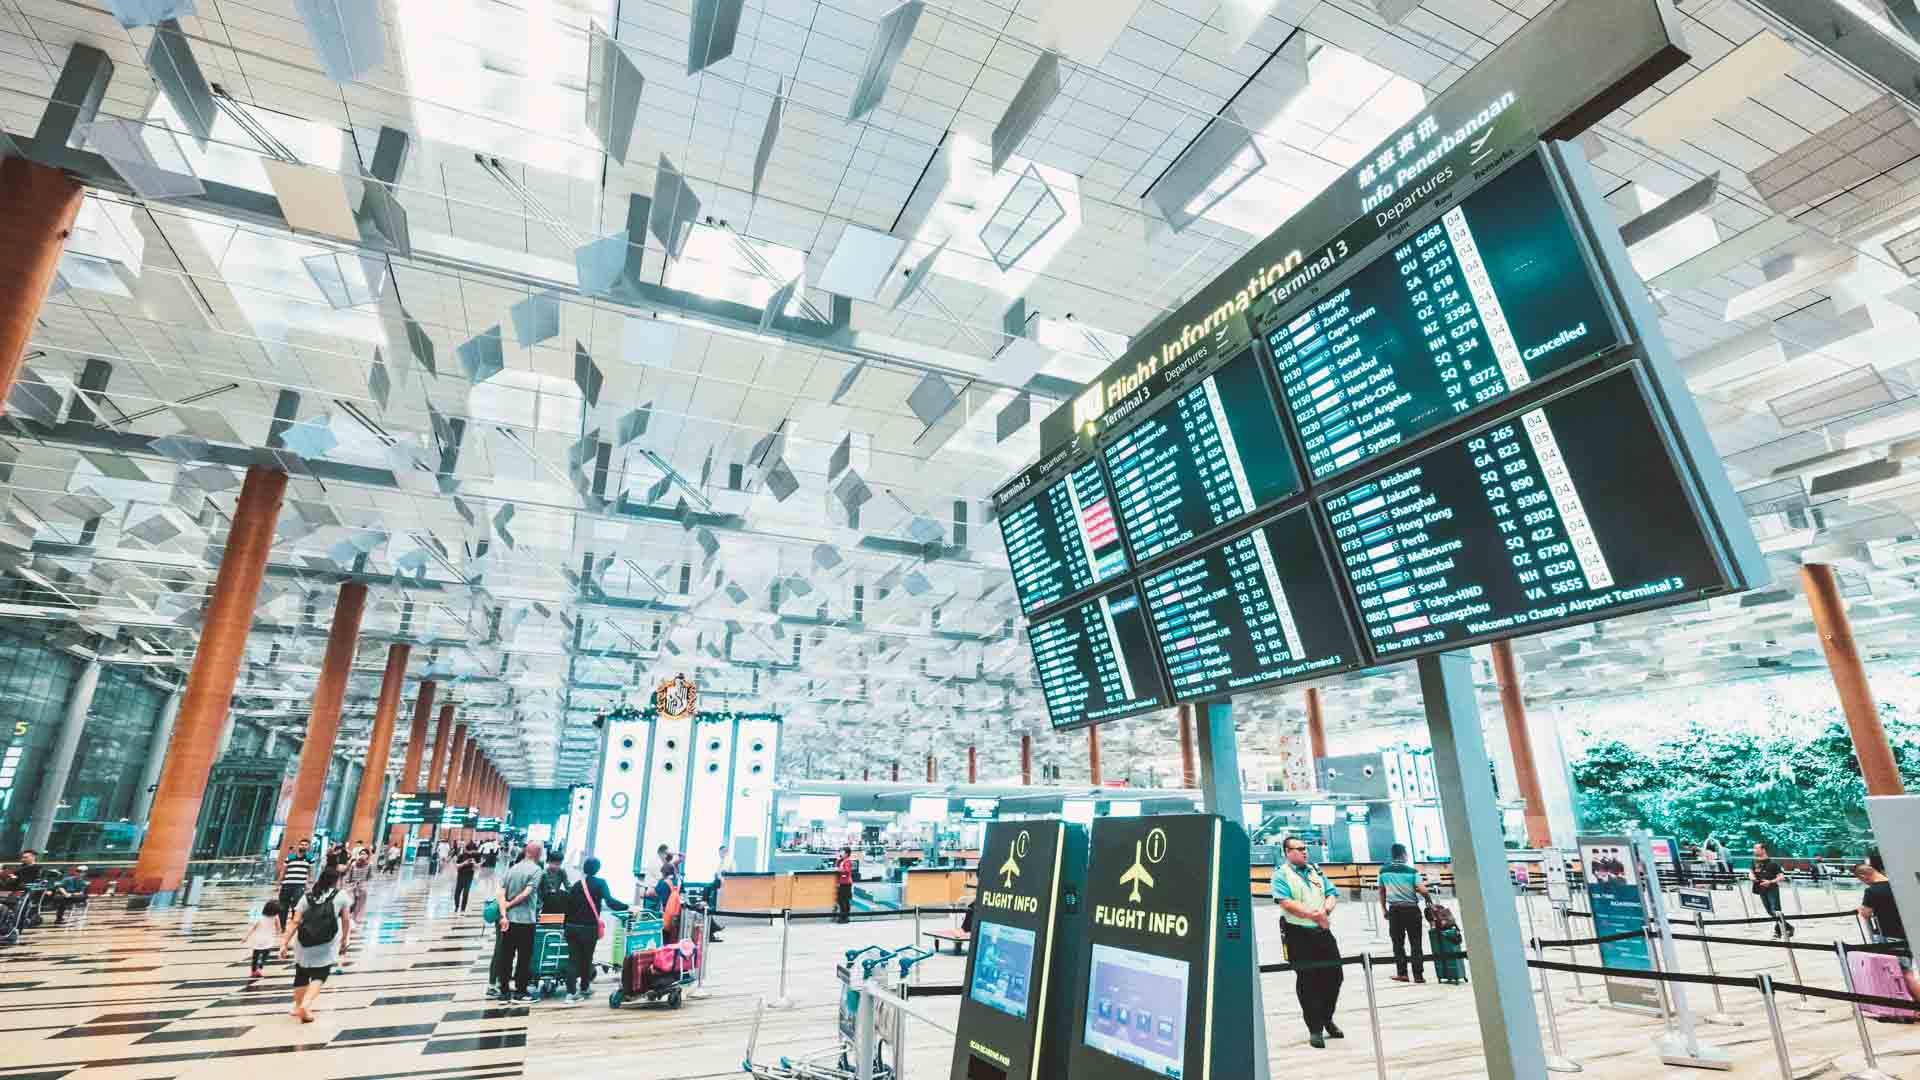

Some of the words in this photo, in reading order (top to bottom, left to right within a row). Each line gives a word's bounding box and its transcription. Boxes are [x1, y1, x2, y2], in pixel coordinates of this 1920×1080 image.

[1361, 183, 1394, 214] Info
[1396, 91, 1514, 186] Penerbangan
[1268, 252, 1335, 305] Terminal
[1337, 240, 1349, 257] 3
[1375, 167, 1454, 228] Departures
[1270, 328, 1288, 345] 0120
[1318, 289, 1350, 314] Nagoya
[1395, 245, 1412, 261] NH
[1416, 225, 1442, 247] 6268
[1447, 213, 1460, 226] 04
[1275, 341, 1293, 357] 0130
[1322, 306, 1349, 327] Zurich
[1401, 259, 1418, 275] OU
[1421, 240, 1447, 262] 5815
[1453, 228, 1466, 242] 04
[1279, 354, 1297, 370] 0130
[1328, 324, 1349, 340] Cape
[1349, 307, 1376, 326] Town
[1406, 276, 1422, 291] SA
[1427, 256, 1453, 278] 7231
[1108, 358, 1157, 407] Flight
[1163, 249, 1304, 363] Information
[1284, 368, 1302, 384] 0130
[1332, 335, 1360, 354] Osaka
[1412, 291, 1428, 306] SQ
[1433, 275, 1454, 293] 618
[1288, 380, 1306, 397] 0145
[1337, 348, 1362, 368] Seoul
[1418, 305, 1434, 320] OZ
[1438, 290, 1459, 308] 754
[1292, 394, 1311, 410] 0150
[1342, 356, 1378, 383] Istanbul
[1423, 321, 1439, 336] NZ
[1445, 302, 1472, 324] 3392
[1104, 391, 1142, 427] Terminal
[1142, 386, 1151, 399] 3
[1164, 346, 1207, 383] Departures
[1297, 407, 1316, 423] 0225
[1347, 381, 1368, 397] New
[1368, 364, 1393, 384] Delhi
[1429, 335, 1447, 351] NH
[1451, 318, 1478, 339] 6278
[1301, 421, 1320, 436] 0230
[1352, 381, 1396, 410] Paris-CDG
[1435, 352, 1452, 366] SQ
[1457, 337, 1478, 355] 334
[1306, 434, 1325, 450] 0230
[1357, 412, 1373, 424] Los
[1375, 393, 1412, 417] Angeles
[1441, 368, 1458, 382] SQ
[1463, 360, 1472, 370] 8
[1310, 448, 1330, 463] 0410
[1363, 418, 1395, 439] Jeddah
[1447, 383, 1461, 398] SV
[1523, 322, 1586, 360] Cancelled
[1313, 461, 1335, 477] 0705
[1367, 432, 1400, 453] Sydney
[1452, 398, 1469, 412] TK
[1476, 381, 1504, 402] 9326
[1511, 373, 1525, 386] 04
[1327, 496, 1347, 511] 0715
[1380, 467, 1422, 489] Brisbane
[1468, 438, 1486, 452] SQ
[1491, 426, 1514, 443] 265
[1528, 415, 1542, 428] 04
[1000, 478, 1024, 504] Terminal
[1024, 475, 1031, 487] 3
[1040, 450, 1067, 474] Departures
[1332, 510, 1352, 525] 0725
[1386, 485, 1421, 504] Jakarta
[1475, 454, 1495, 468] GA
[1498, 442, 1520, 459] 823
[1535, 432, 1549, 444] 05
[1336, 524, 1357, 538] 0730
[1391, 494, 1436, 518] Shanghai
[1481, 470, 1499, 484] SQ
[1504, 459, 1527, 475] 828
[1541, 449, 1556, 461] 04
[1342, 538, 1362, 552] 0735
[1396, 518, 1424, 533] Hong
[1424, 508, 1452, 523] Kong
[1486, 487, 1505, 501] SQ
[1510, 476, 1534, 492] 890
[1227, 557, 1237, 566] TK
[1240, 549, 1256, 562] 9324
[1346, 552, 1367, 566] 0740
[1401, 532, 1429, 548] Perth
[1493, 503, 1511, 516] TK
[1517, 490, 1548, 508] 9306
[1555, 483, 1570, 496] 04
[1352, 566, 1372, 580] 0745
[1407, 540, 1462, 563] Melbourne
[1499, 520, 1517, 533] TK
[1524, 507, 1555, 525] 9302
[1562, 501, 1577, 514] 04
[1356, 581, 1377, 594] 0745
[1412, 557, 1454, 578] Mumbai
[1506, 536, 1525, 550] SQ
[1532, 527, 1555, 541] 422
[1569, 519, 1585, 531] 04
[1230, 569, 1242, 578] VA
[1243, 561, 1260, 574] 5680
[1235, 582, 1245, 591] SQ
[1248, 577, 1257, 586] 22
[1239, 594, 1249, 603] SQ
[1251, 588, 1264, 599] 231
[1243, 606, 1254, 616] SQ
[1256, 601, 1269, 611] 255
[1361, 595, 1383, 608] 0805
[1418, 577, 1447, 593] Seoul
[1513, 553, 1532, 566] OZ
[1538, 543, 1569, 559] 6790
[1577, 536, 1592, 547] 04
[1366, 610, 1388, 623] 0805
[1423, 586, 1482, 608] Tokyo-HND
[1518, 569, 1539, 583] NH
[1544, 560, 1576, 576] 6250
[1371, 625, 1393, 638] 0810
[1430, 603, 1490, 624] Guangzhou
[1525, 587, 1546, 600] VA
[1552, 578, 1583, 594] 5655
[1591, 572, 1607, 584] 04
[1376, 644, 1386, 653] 25
[1423, 631, 1445, 642] 20:19
[1467, 618, 1514, 633] Welcome
[1514, 614, 1527, 623] to
[1528, 603, 1567, 620] Changi
[1569, 594, 1613, 611] Airport
[1612, 579, 1672, 601] Terminal
[1672, 578, 1684, 589] 3
[14, 721, 29, 736] 5
[610, 792, 629, 819] 9
[982, 891, 1014, 910] FLIGHT
[1014, 895, 1038, 913] INFO
[1095, 905, 1145, 930] FLIGHT
[1148, 913, 1189, 937] INFO
